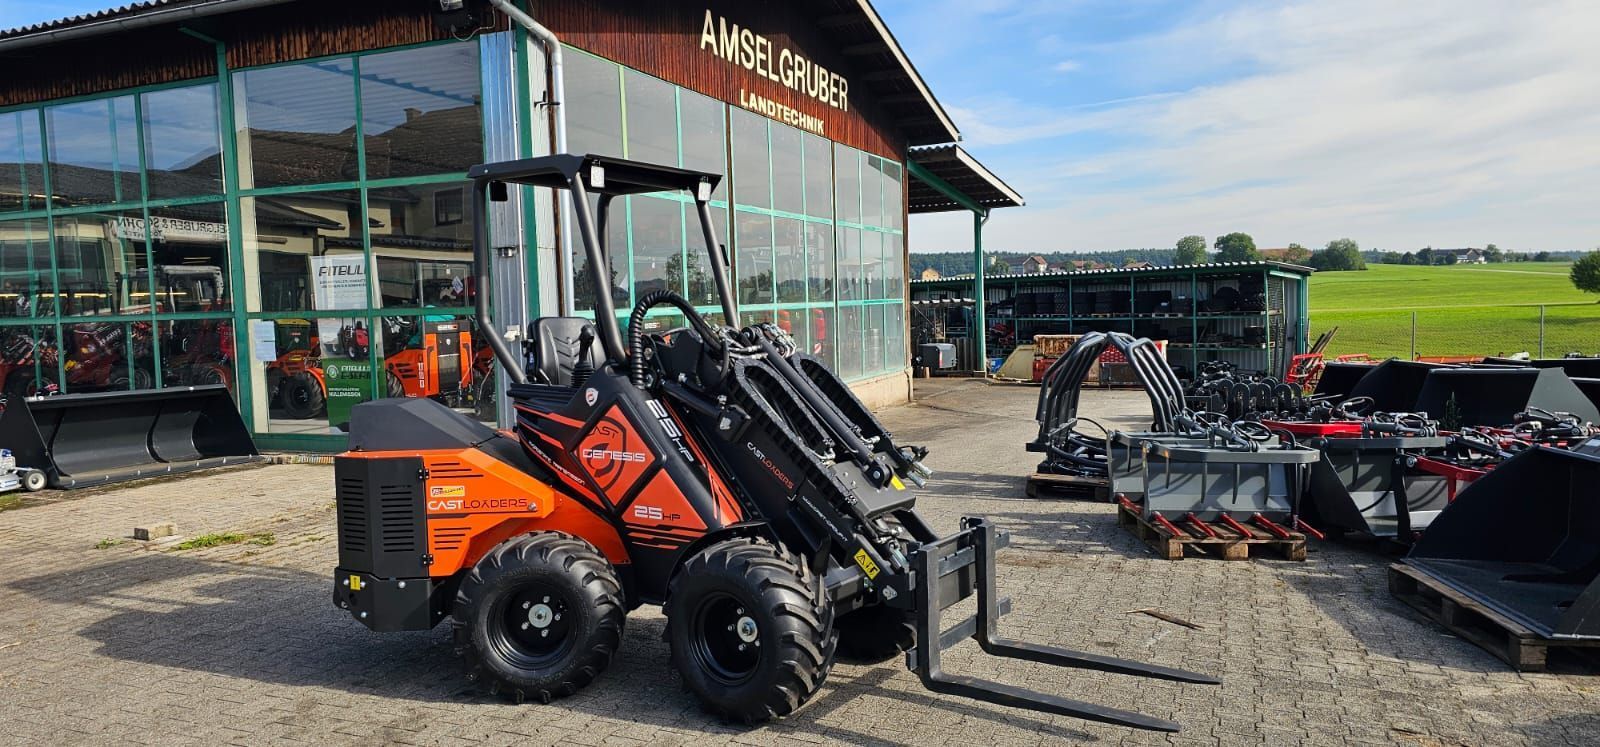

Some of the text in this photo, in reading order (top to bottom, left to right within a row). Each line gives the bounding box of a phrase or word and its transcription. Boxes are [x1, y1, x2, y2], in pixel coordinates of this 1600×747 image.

[700, 8, 848, 112] AMSELGRUBER
[740, 88, 825, 134] LANDTECHNIK
[582, 448, 646, 463] GENESIS
[427, 498, 529, 511] CASTLOADERS
